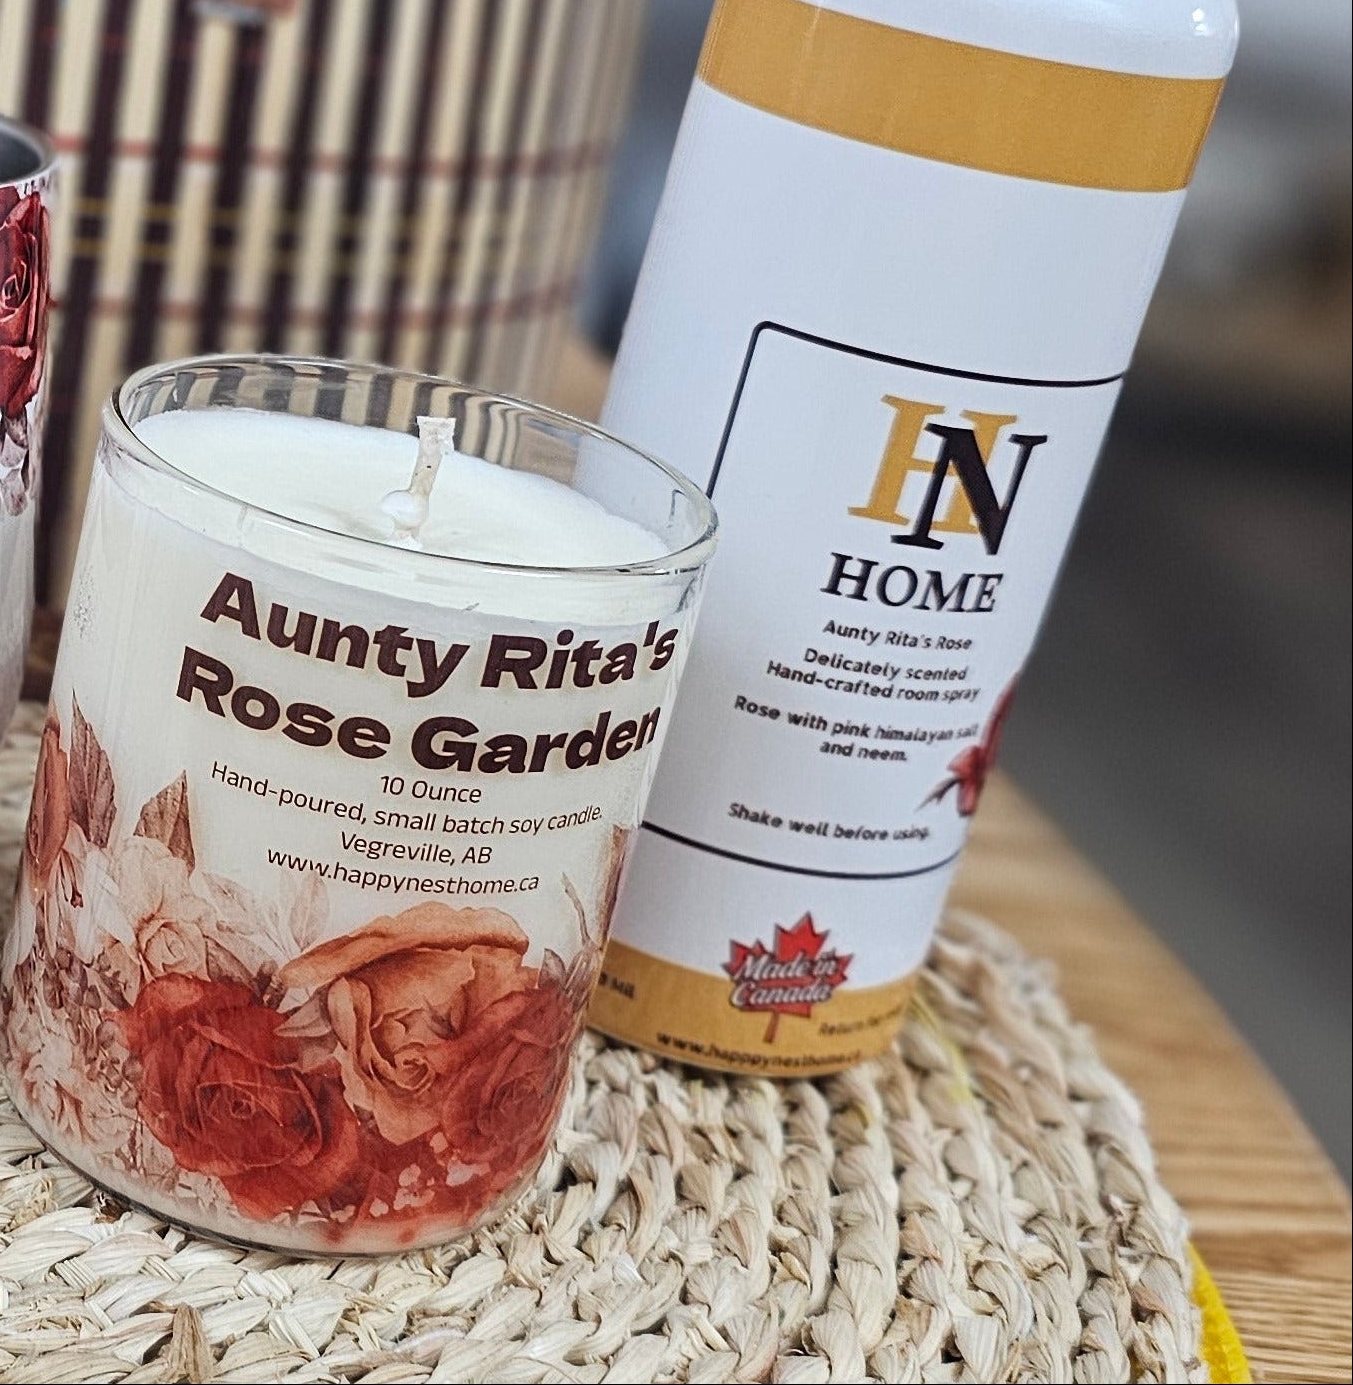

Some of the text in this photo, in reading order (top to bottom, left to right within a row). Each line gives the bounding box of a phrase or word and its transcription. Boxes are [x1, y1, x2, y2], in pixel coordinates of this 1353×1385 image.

[819, 552, 1004, 613] HOME
[200, 572, 679, 698] Aunty Rita's
[823, 619, 973, 650] Aunty Rita's Rose
[767, 660, 981, 705] Hand-crafted room spray
[804, 647, 968, 681] Delicately scented
[176, 646, 661, 774] Rose Garden
[734, 695, 781, 720] Rose
[787, 709, 828, 732] with
[831, 720, 871, 738] pink
[874, 723, 953, 745] himalayan
[820, 740, 853, 757] and
[211, 761, 603, 836] Hand-poured, small batch soy candle.
[381, 775, 482, 803] 10 Ounce
[727, 802, 784, 828] Shake
[788, 817, 828, 838] well
[833, 825, 889, 841] before
[341, 831, 492, 866] Vegreville, AB
[267, 848, 539, 895] www.happynesthome.ca
[733, 951, 838, 980] Made in
[730, 977, 833, 1008] Canada
